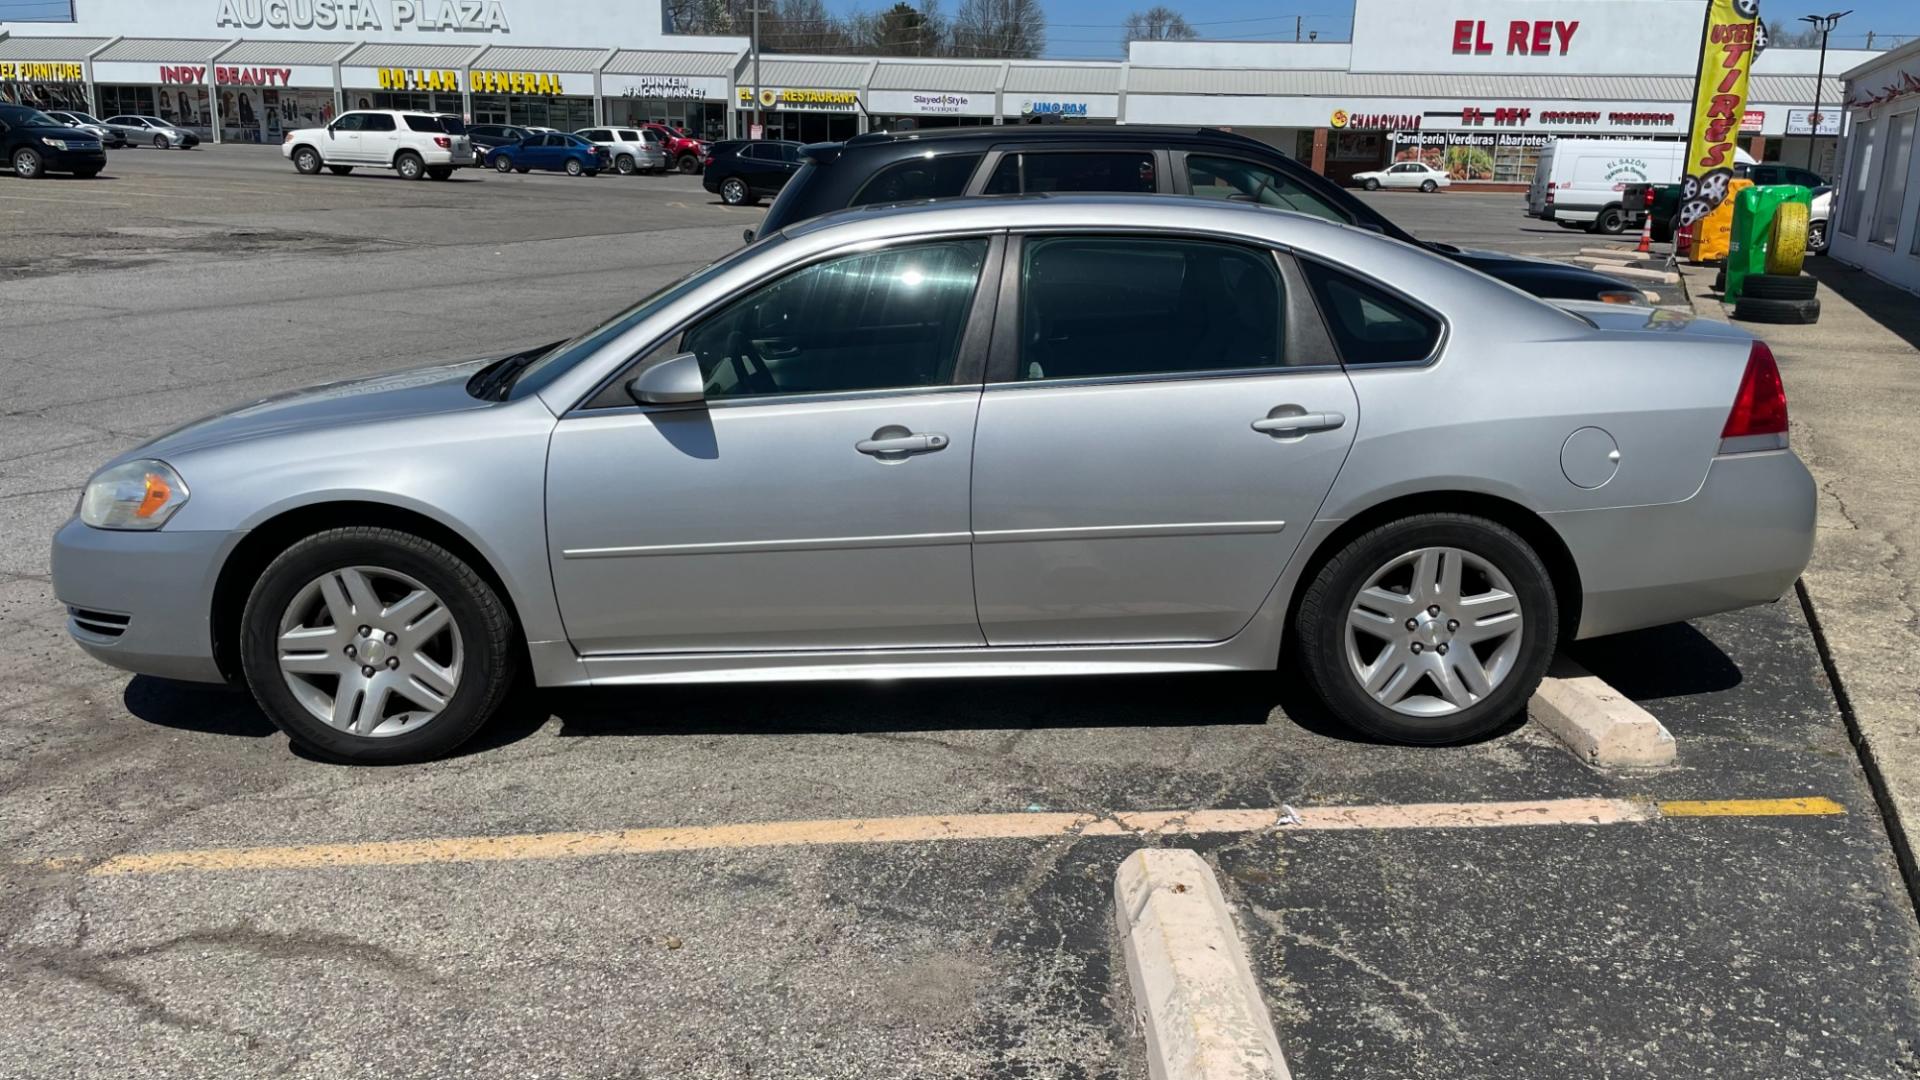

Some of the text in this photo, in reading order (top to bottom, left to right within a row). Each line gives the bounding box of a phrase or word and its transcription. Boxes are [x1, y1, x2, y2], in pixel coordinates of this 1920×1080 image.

[216, 0, 510, 33] AUGUSTA PLAZA
[1452, 20, 1579, 55] EL REY
[19, 63, 82, 80] FURNITURE
[160, 66, 291, 86] INDY BEAUTY
[378, 67, 562, 94] DOLLAR GENERAL
[641, 77, 688, 88] DUNKEM
[622, 86, 706, 99] AFRICAN MARKET
[739, 88, 857, 103] EL RESTAURANT
[913, 95, 968, 106] Slayed Style
[1033, 102, 1088, 114] UNO TAX
[1700, 43, 1752, 167] TIRES
[1350, 113, 1422, 131] CHAMOYADAS
[1462, 107, 1485, 124] EL
[1494, 107, 1530, 125] REY
[1396, 132, 1445, 144] Carniceria
[1449, 133, 1494, 145] Verduras
[1499, 134, 1547, 147] Abarrotes
